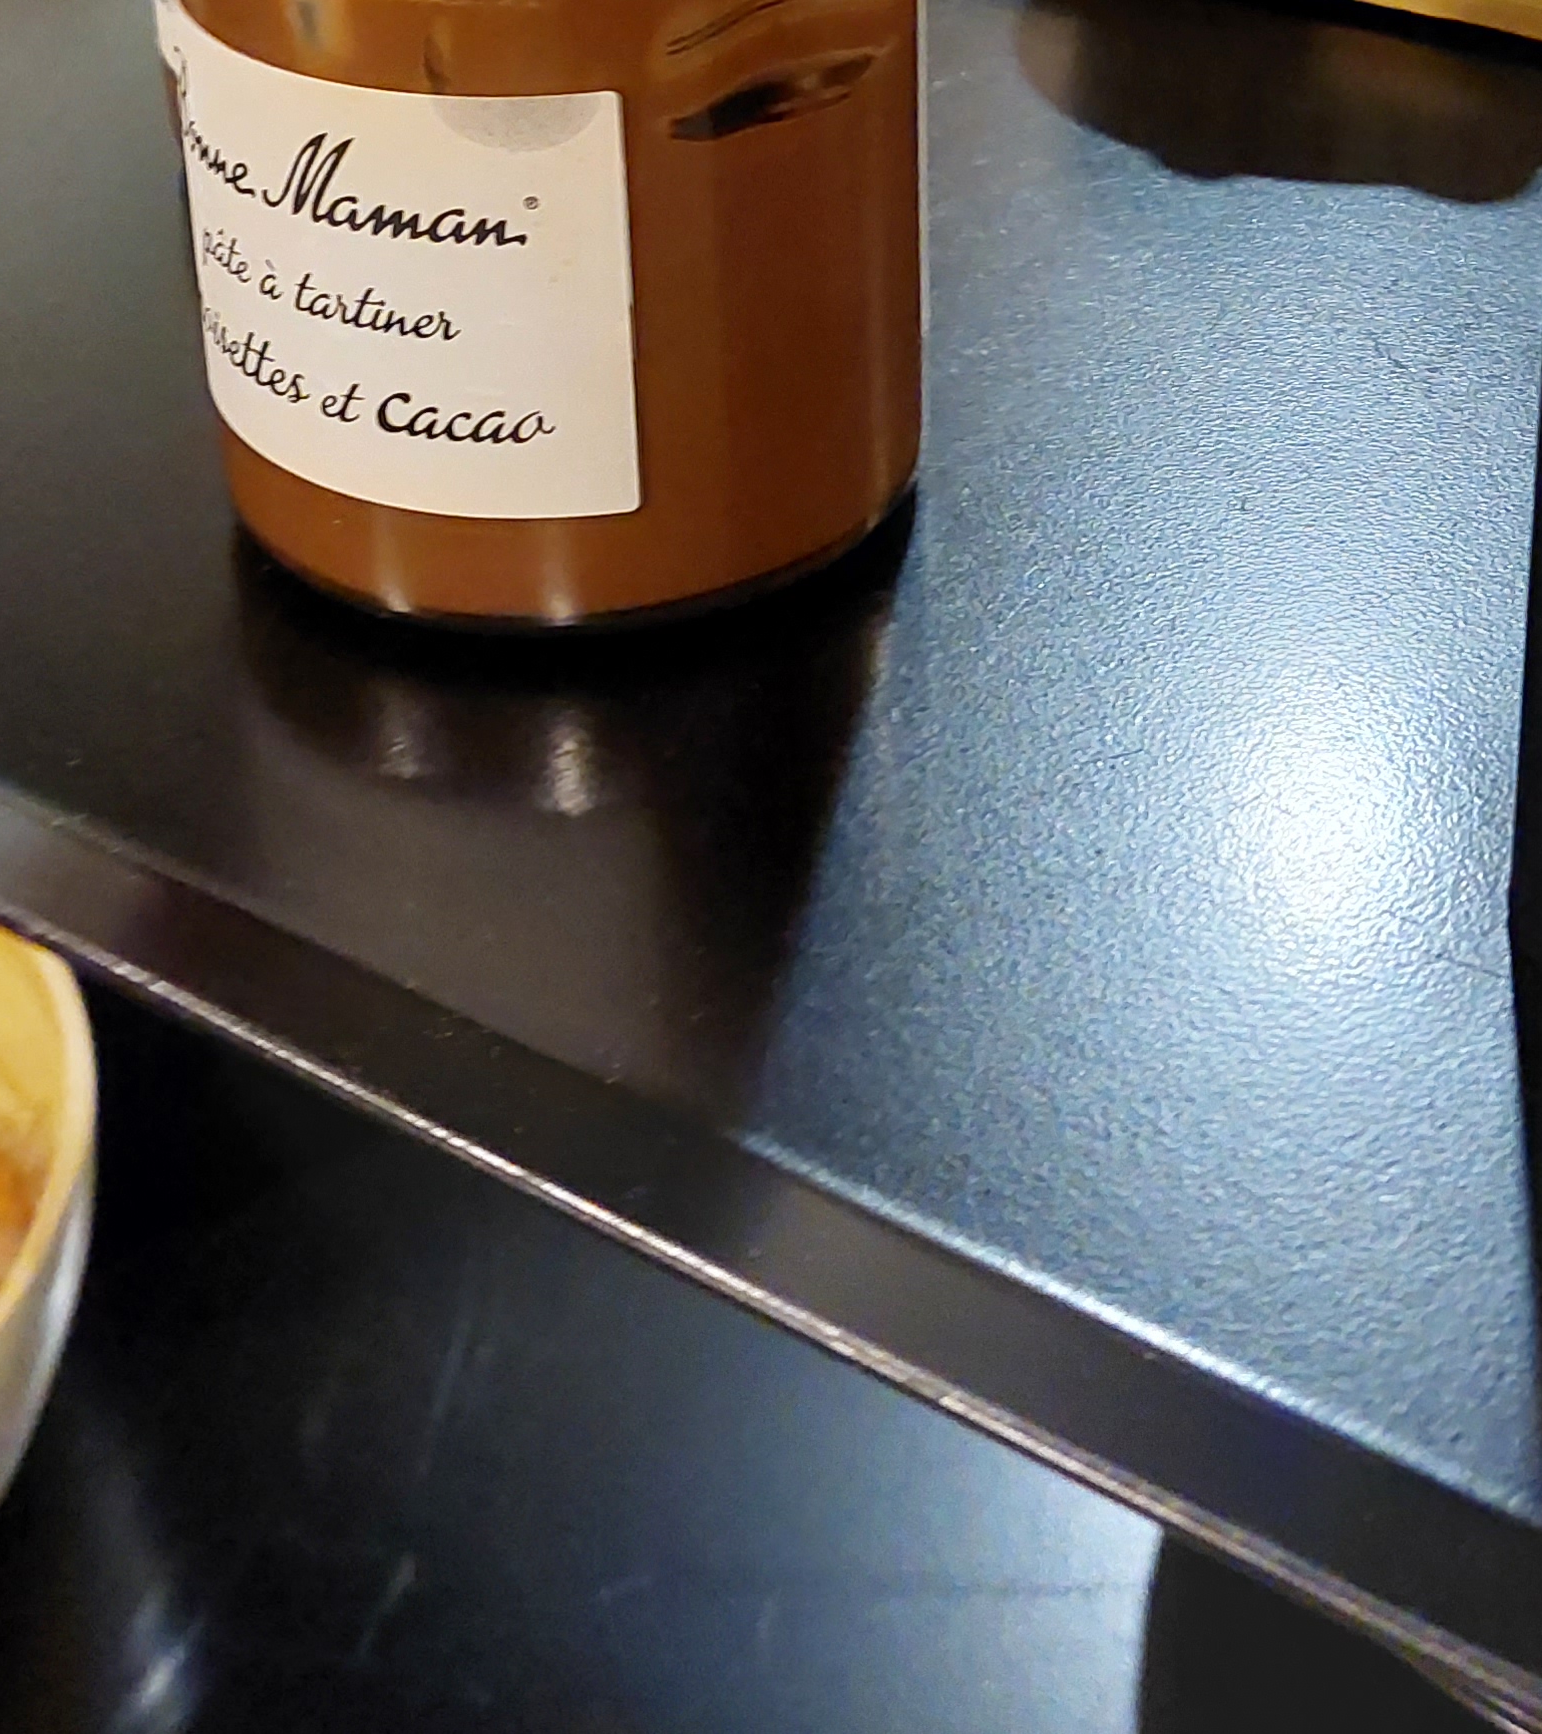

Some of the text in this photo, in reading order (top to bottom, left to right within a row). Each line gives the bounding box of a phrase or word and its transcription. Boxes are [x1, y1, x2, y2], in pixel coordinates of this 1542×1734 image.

[258, 258, 284, 301] à
[293, 271, 463, 342] tartiner
[320, 382, 366, 425] et
[376, 391, 556, 445] Cacao
